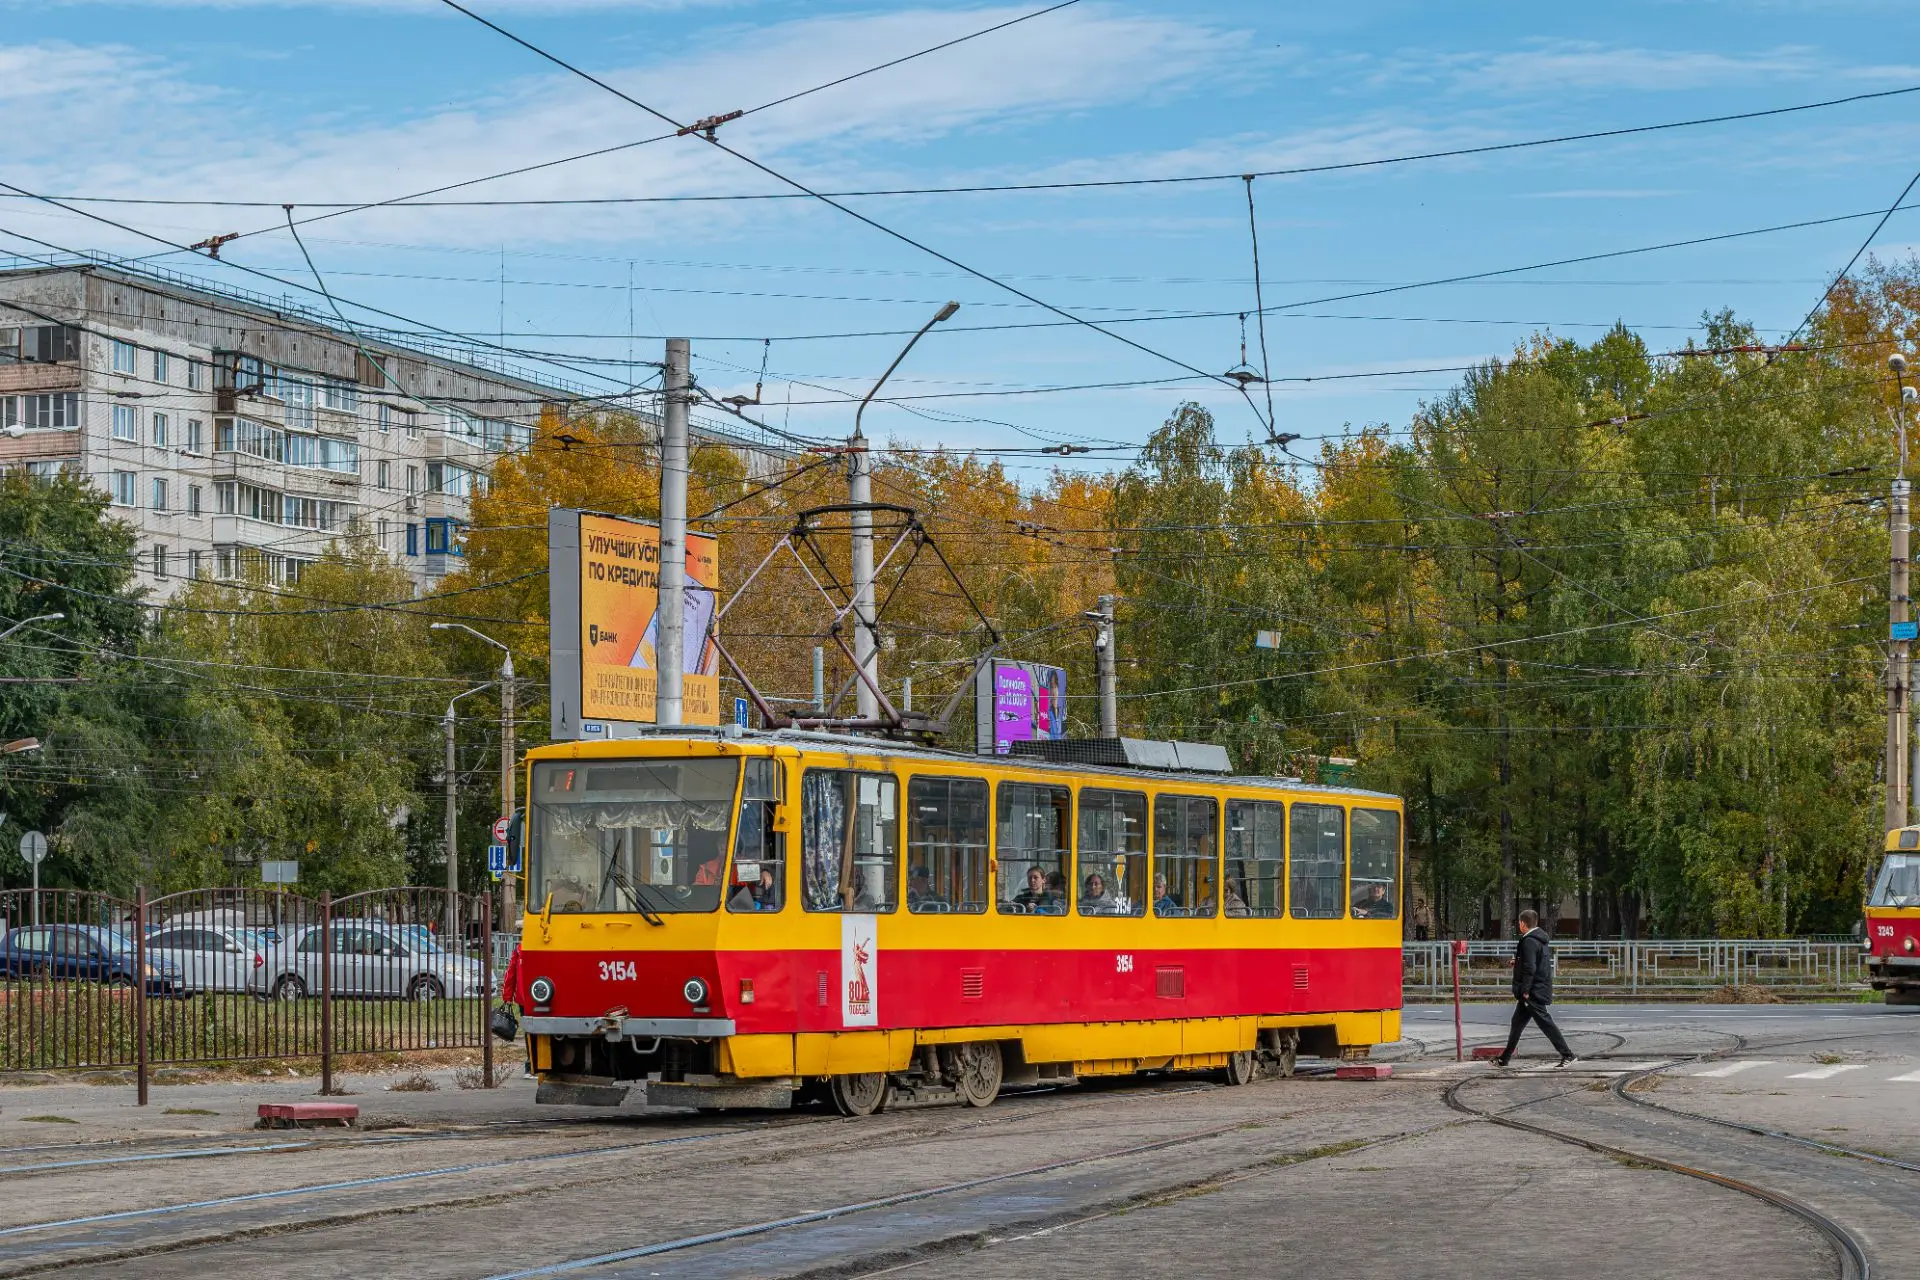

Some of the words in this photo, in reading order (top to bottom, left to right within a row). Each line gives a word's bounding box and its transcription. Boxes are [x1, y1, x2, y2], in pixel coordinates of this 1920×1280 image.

[589, 535, 636, 560] УЛУЧШИ
[637, 542, 659, 565] УСЛ
[588, 561, 605, 581] ПО
[607, 564, 659, 590] КРЕДИТА
[600, 630, 618, 644] БАНК
[1115, 897, 1131, 914] 3154
[1878, 926, 1893, 937] 3243
[598, 961, 638, 981] 3154
[1116, 955, 1133, 972] 3154
[848, 980, 861, 1001] 80
